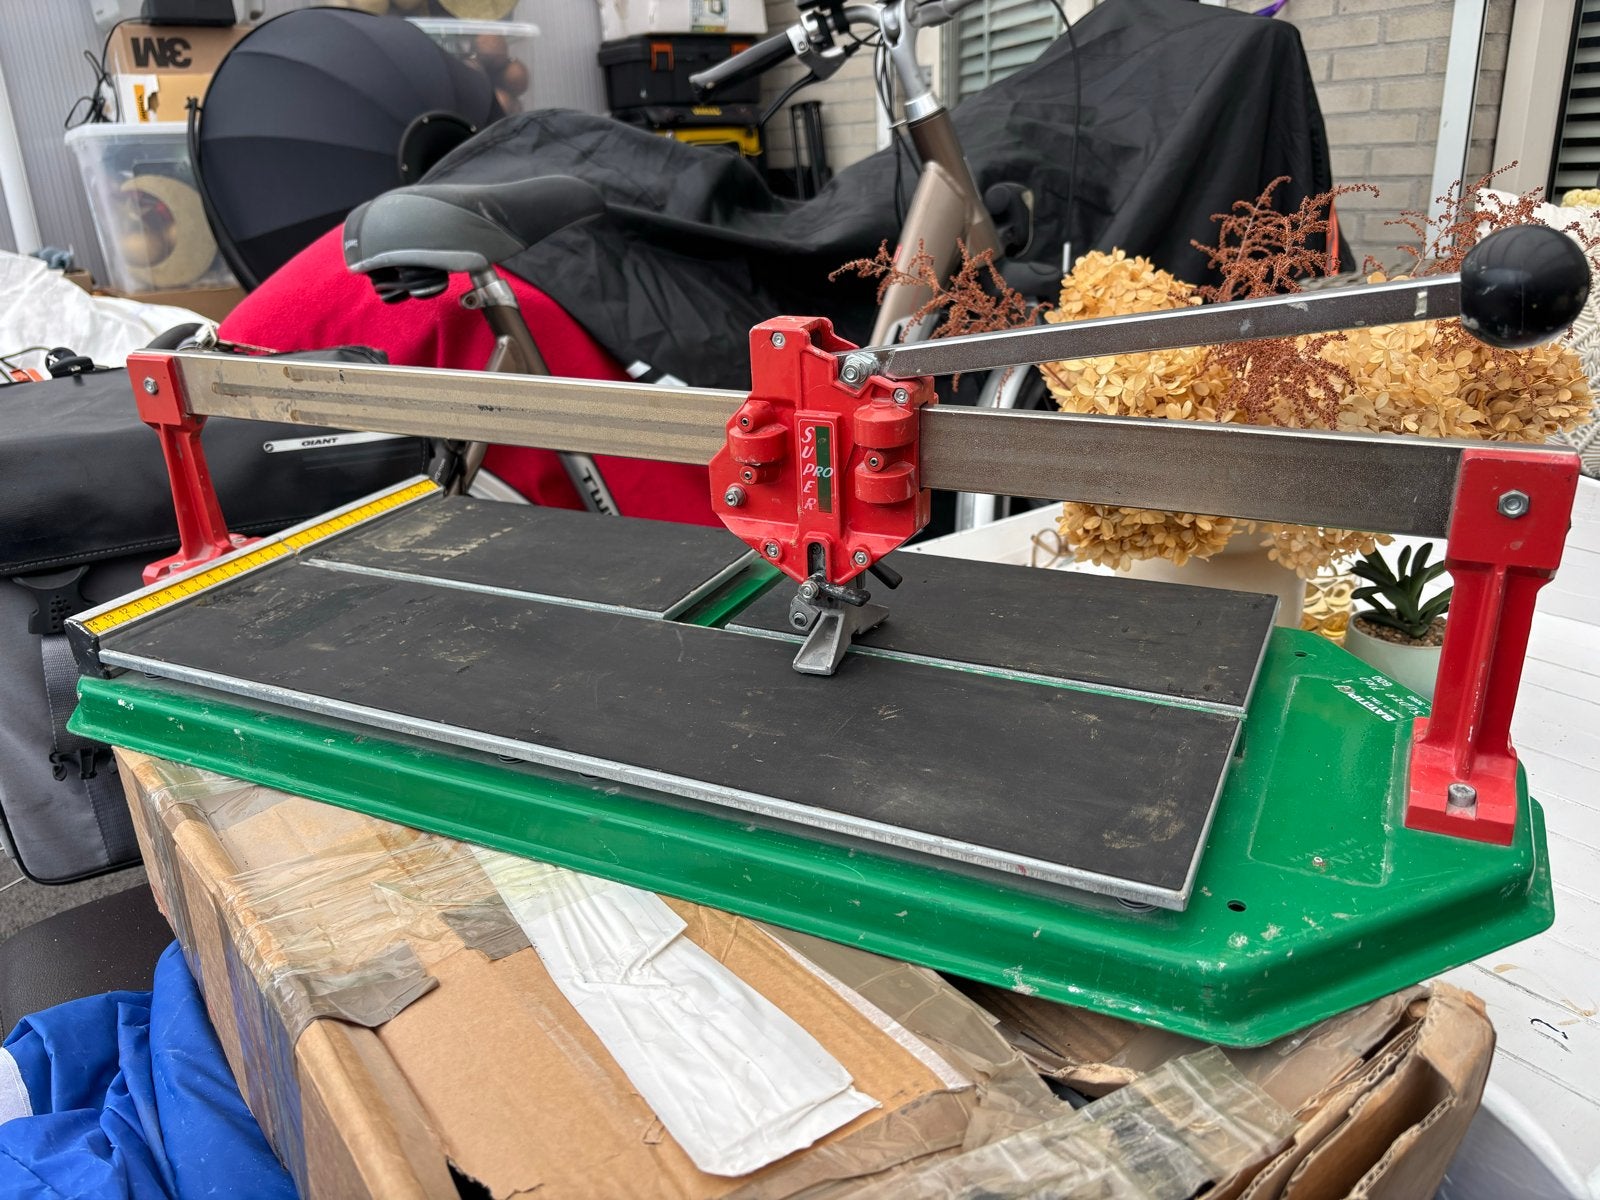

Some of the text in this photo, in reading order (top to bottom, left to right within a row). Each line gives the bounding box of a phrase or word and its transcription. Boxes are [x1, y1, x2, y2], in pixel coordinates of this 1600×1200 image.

[131, 36, 192, 68] 3M
[301, 437, 339, 447] GIANT
[801, 426, 817, 511] SUPER
[583, 467, 612, 515] TW
